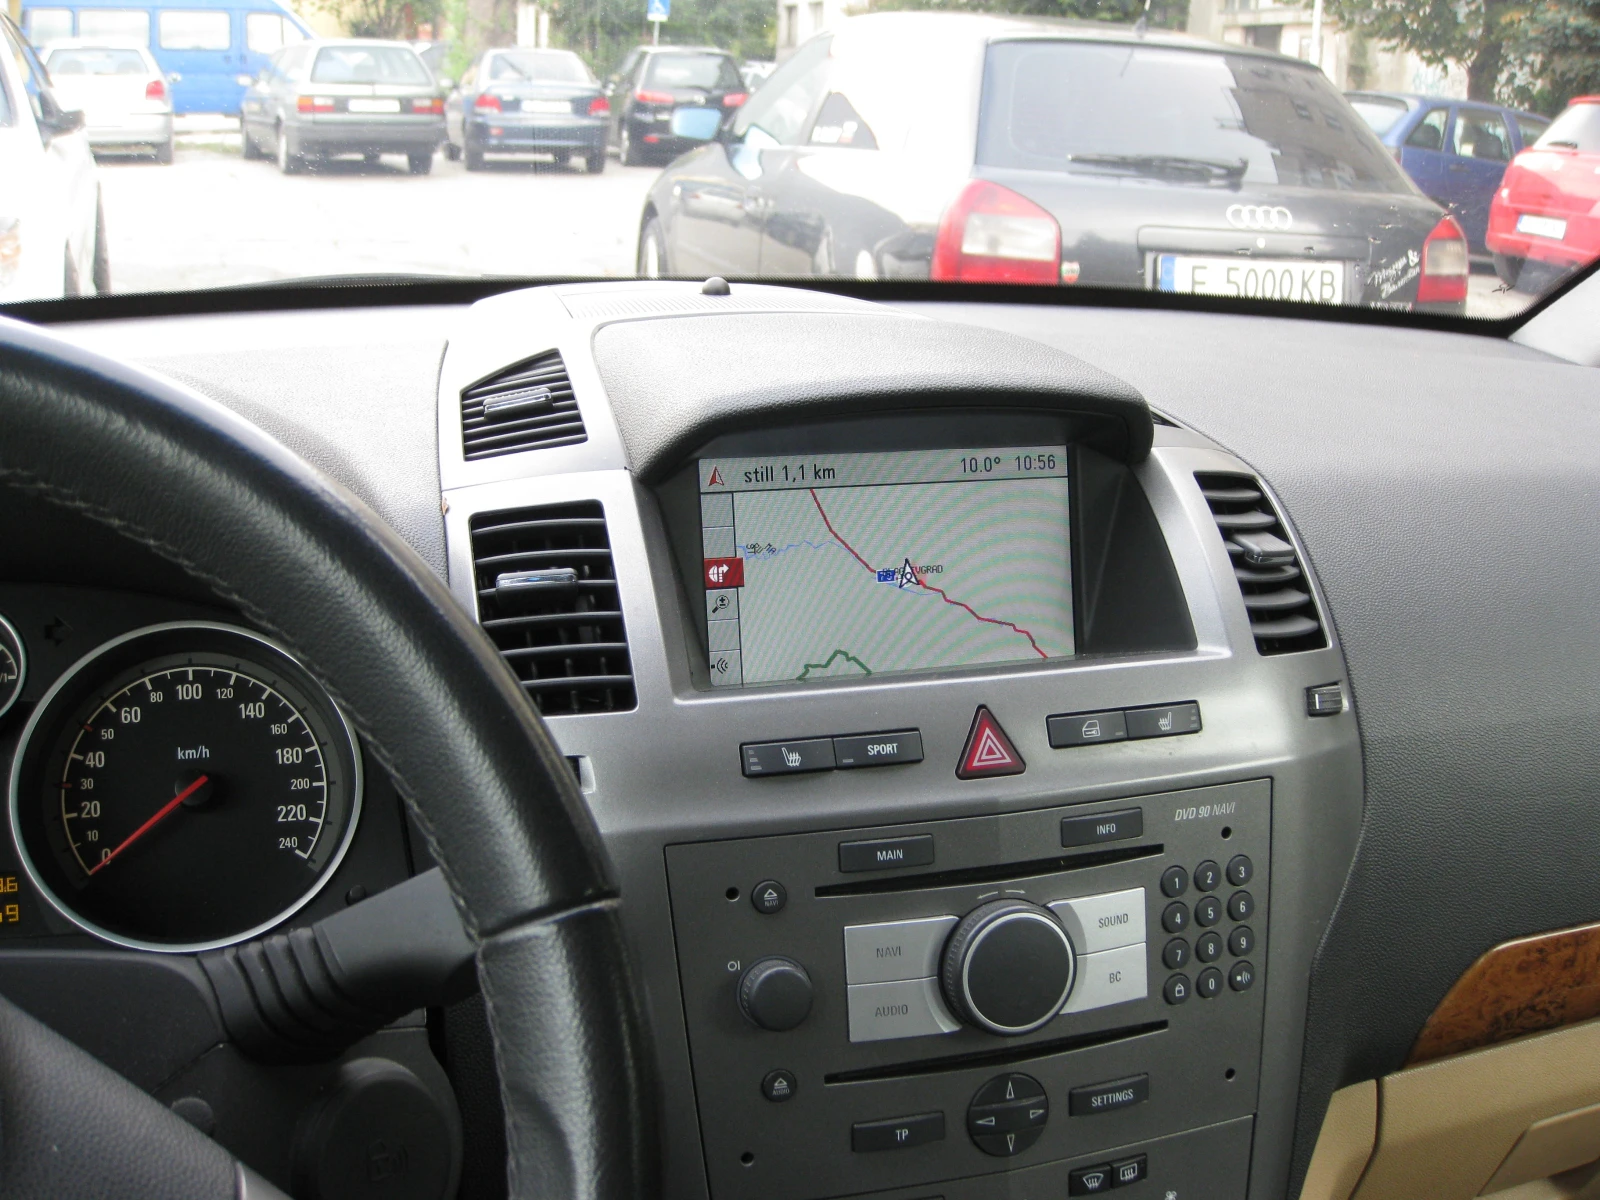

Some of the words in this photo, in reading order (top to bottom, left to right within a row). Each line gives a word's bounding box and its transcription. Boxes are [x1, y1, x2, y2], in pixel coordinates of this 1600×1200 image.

[1014, 454, 1056, 471] 10:56
[743, 465, 774, 483] still
[782, 464, 806, 483] 1,1
[813, 464, 836, 480] km
[150, 691, 163, 703] 80
[176, 683, 202, 700] 100
[216, 687, 234, 700] 120
[121, 706, 141, 724] 60
[239, 702, 265, 720] 140
[101, 728, 115, 740] 50
[270, 723, 288, 736] 160
[177, 745, 210, 760] km/h
[275, 747, 303, 765] 180
[867, 743, 898, 756] SPORT
[85, 751, 105, 768] 40
[80, 778, 94, 790] 30
[290, 778, 310, 790] 200
[81, 800, 101, 818] 20
[277, 803, 307, 822] 220
[1175, 807, 1196, 821] DVD
[1198, 805, 1210, 818] 90
[1212, 801, 1236, 816] NAVI
[1096, 823, 1116, 835] INFO
[87, 830, 99, 842] 10
[279, 836, 298, 849] 240
[877, 848, 903, 862] MAIN
[1206, 871, 1213, 884] 2
[1239, 866, 1245, 878] 3
[1207, 907, 1214, 919] 5
[1239, 901, 1246, 913] 6
[1098, 913, 1129, 929] SOUND
[1175, 912, 1181, 925] 4
[1208, 942, 1214, 955] 8
[1240, 937, 1246, 949] 9
[876, 945, 902, 958] NAVI
[1176, 950, 1182, 962] 7
[1109, 971, 1122, 984] BC
[1208, 978, 1215, 990] 0
[875, 1004, 909, 1018] AUDIO
[1091, 1088, 1134, 1108] SETTINGS
[895, 1129, 909, 1142] TP
